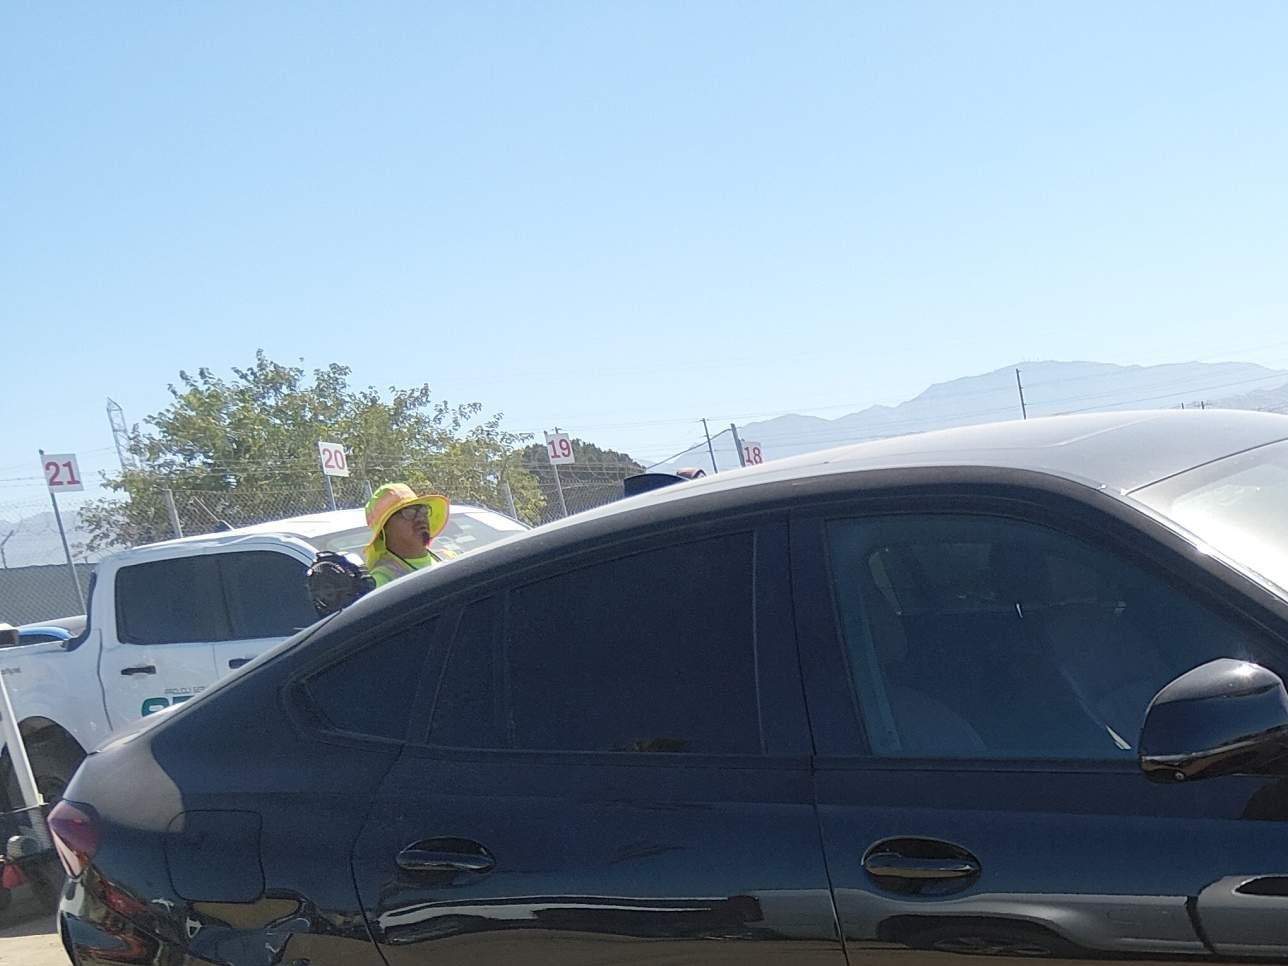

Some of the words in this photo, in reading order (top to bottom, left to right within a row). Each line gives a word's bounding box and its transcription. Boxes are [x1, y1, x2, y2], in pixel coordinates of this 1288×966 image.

[322, 448, 346, 470] 20
[547, 438, 572, 459] 19
[744, 446, 764, 466] 18
[45, 461, 81, 486] 21
